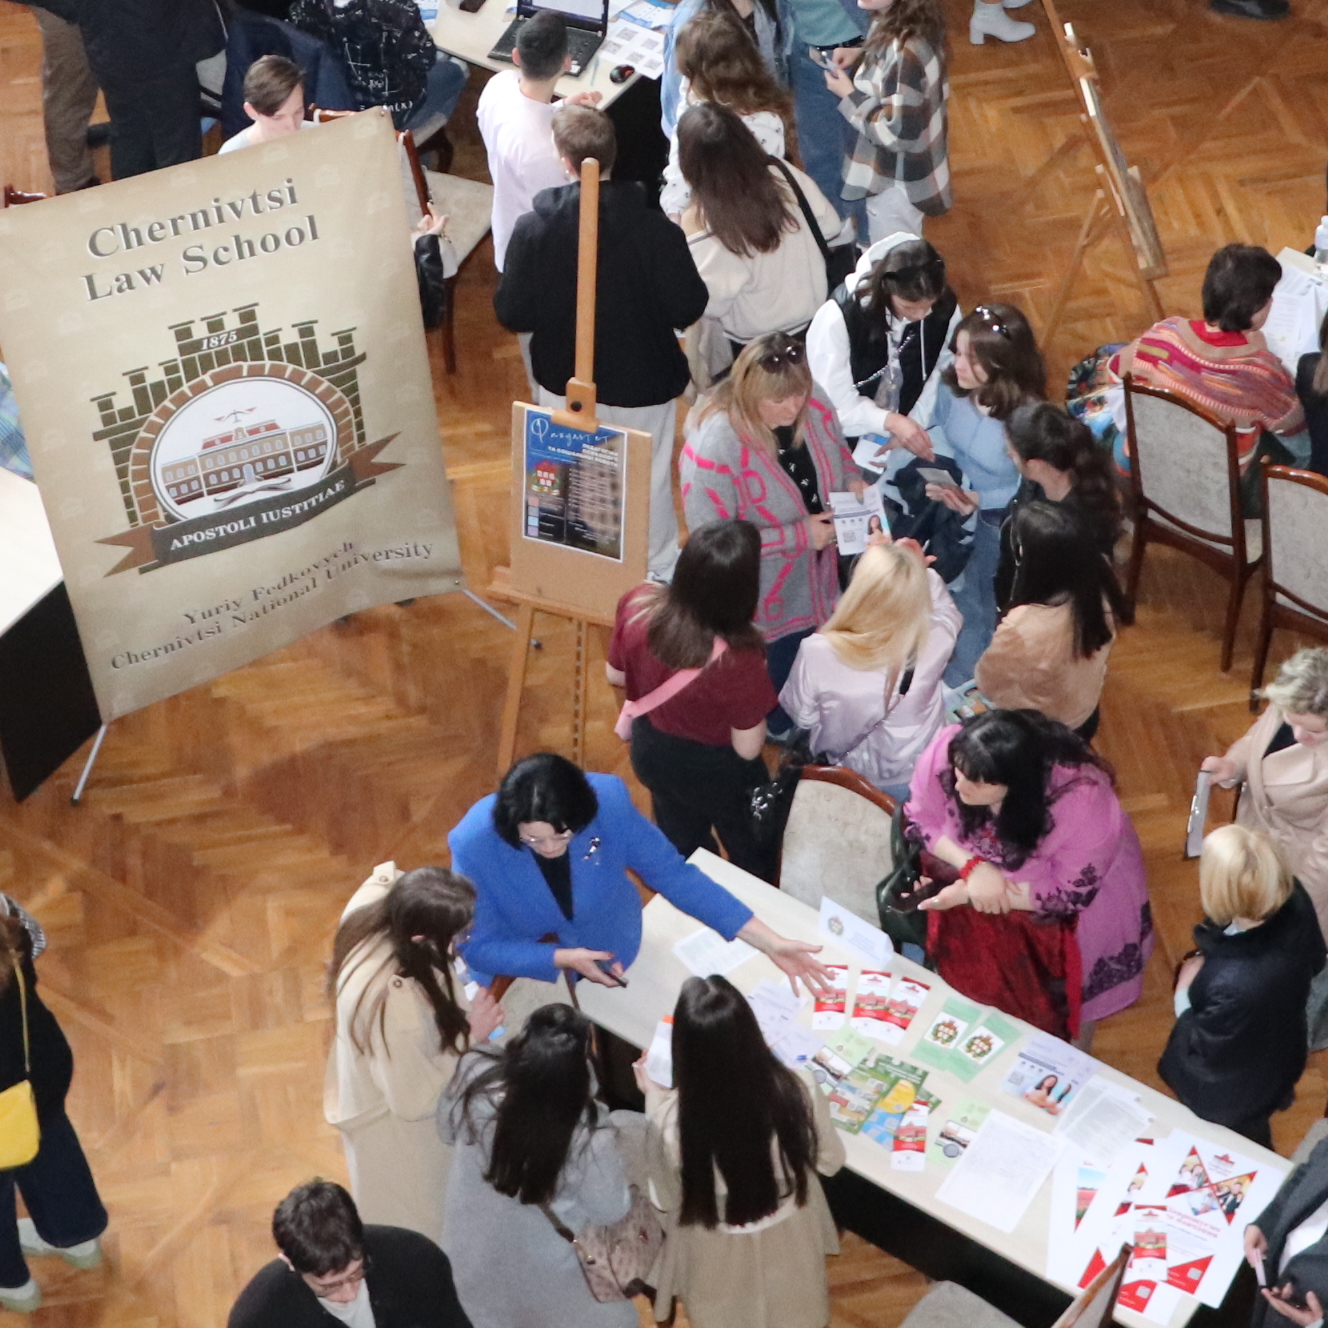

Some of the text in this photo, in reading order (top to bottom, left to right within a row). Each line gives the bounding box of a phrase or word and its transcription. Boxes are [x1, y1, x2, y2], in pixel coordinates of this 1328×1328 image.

[82, 214, 321, 302] Law School
[87, 178, 299, 259] Chernivtsi
[200, 330, 239, 350] 1875
[169, 479, 346, 551] APOSTOLI IUSTITIAE
[110, 541, 435, 671] Chernivtsi National University
[183, 539, 356, 627] Yuriy Fedkovych
